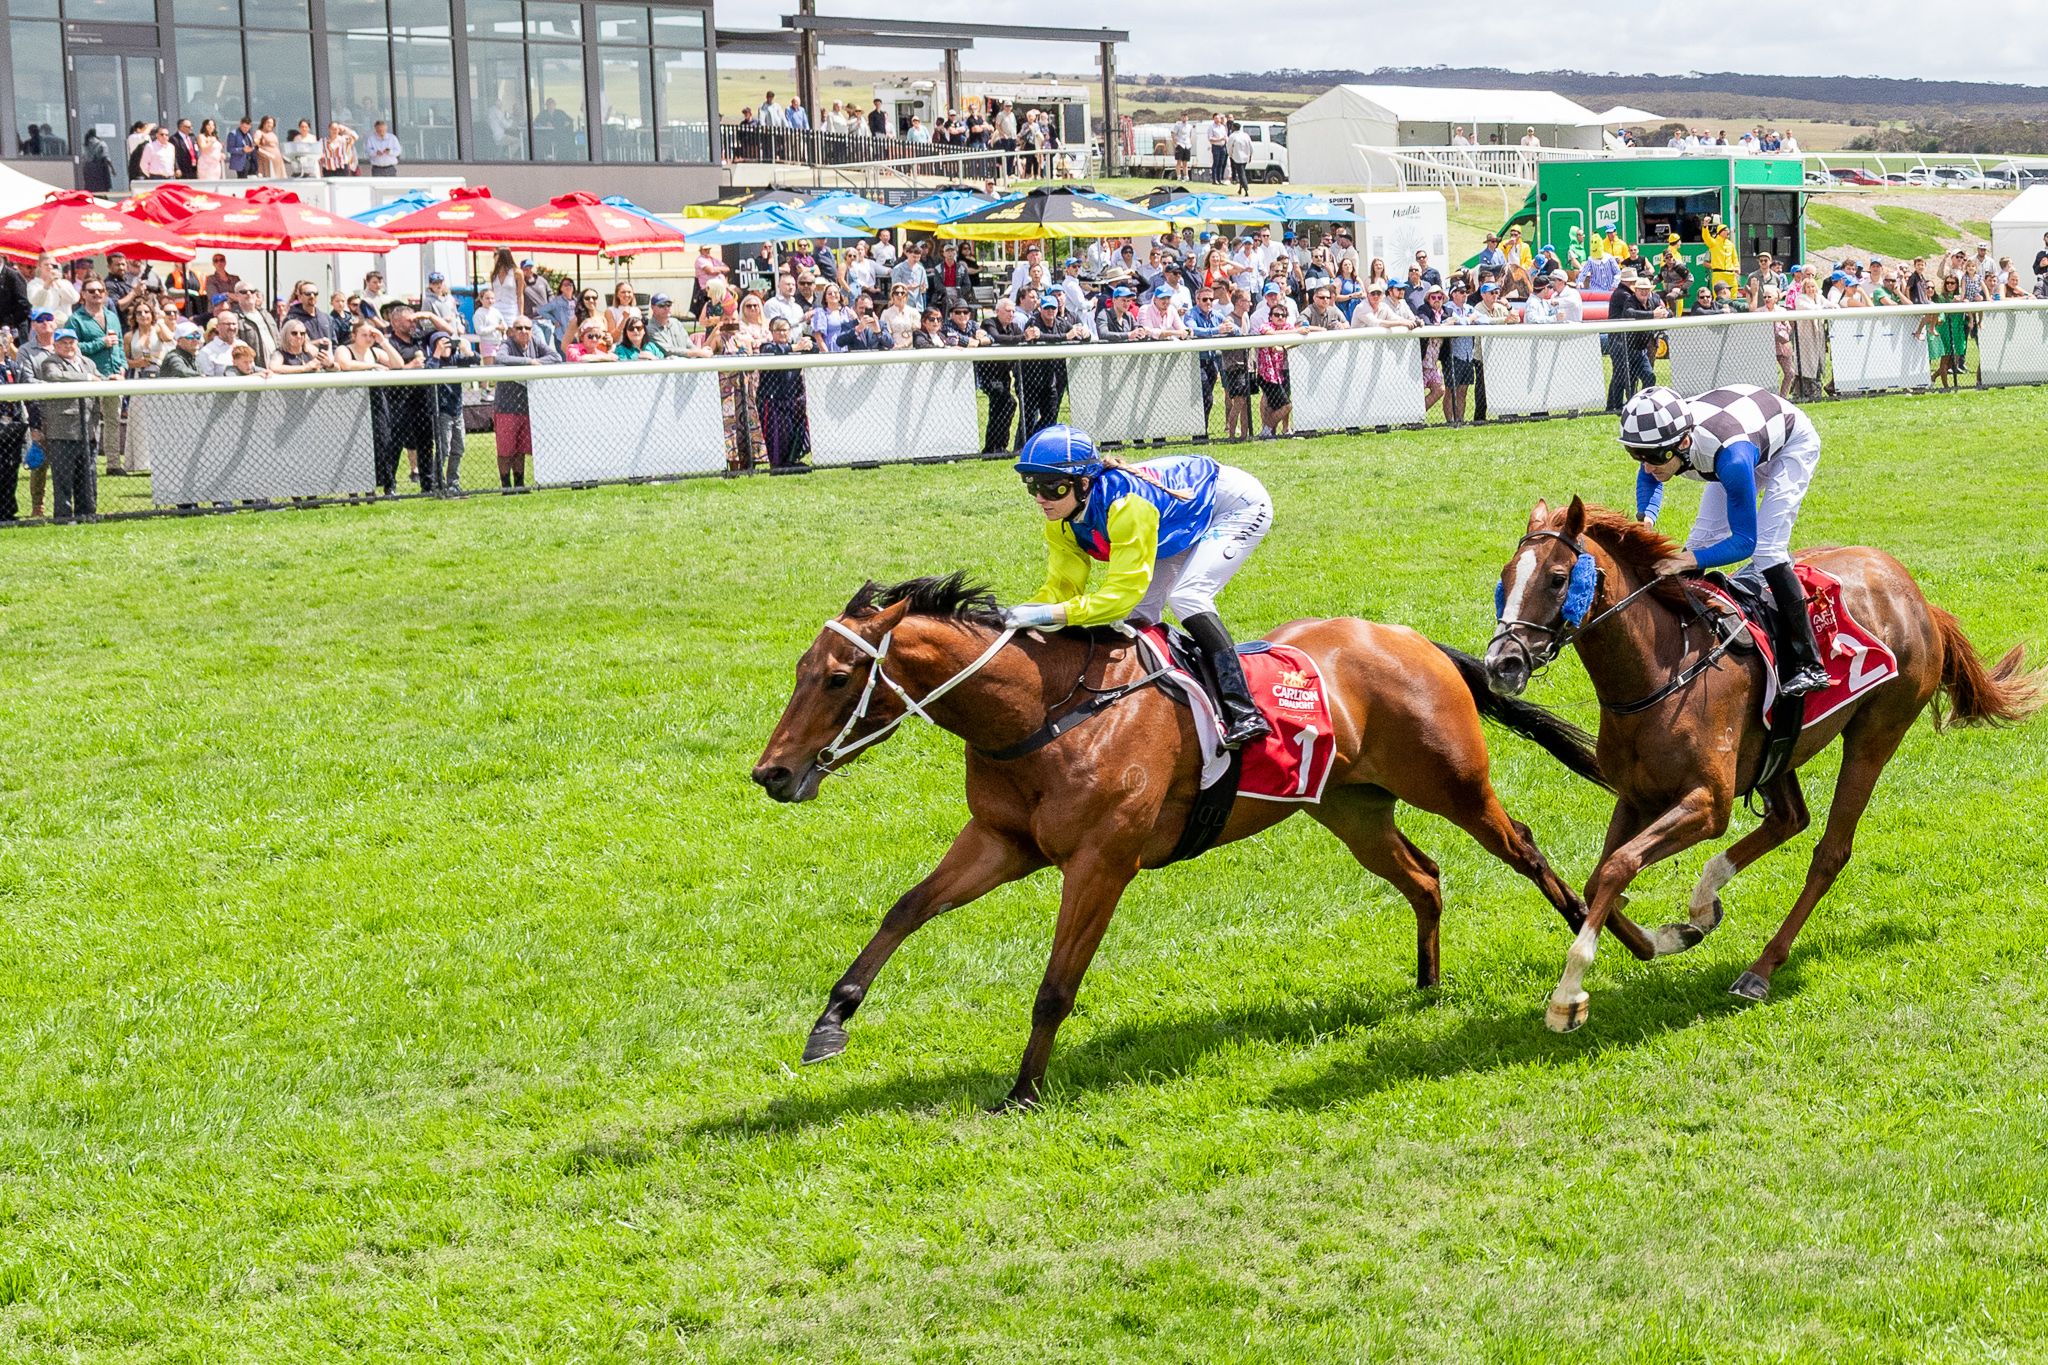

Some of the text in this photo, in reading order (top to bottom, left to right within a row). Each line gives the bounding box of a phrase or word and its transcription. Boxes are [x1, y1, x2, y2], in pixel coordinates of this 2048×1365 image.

[1600, 210, 1617, 220] TAB
[1830, 633, 1889, 693] 2
[1272, 685, 1320, 702] CARLTON
[1278, 698, 1315, 710] DRAUGHT
[1293, 724, 1319, 795] 1
